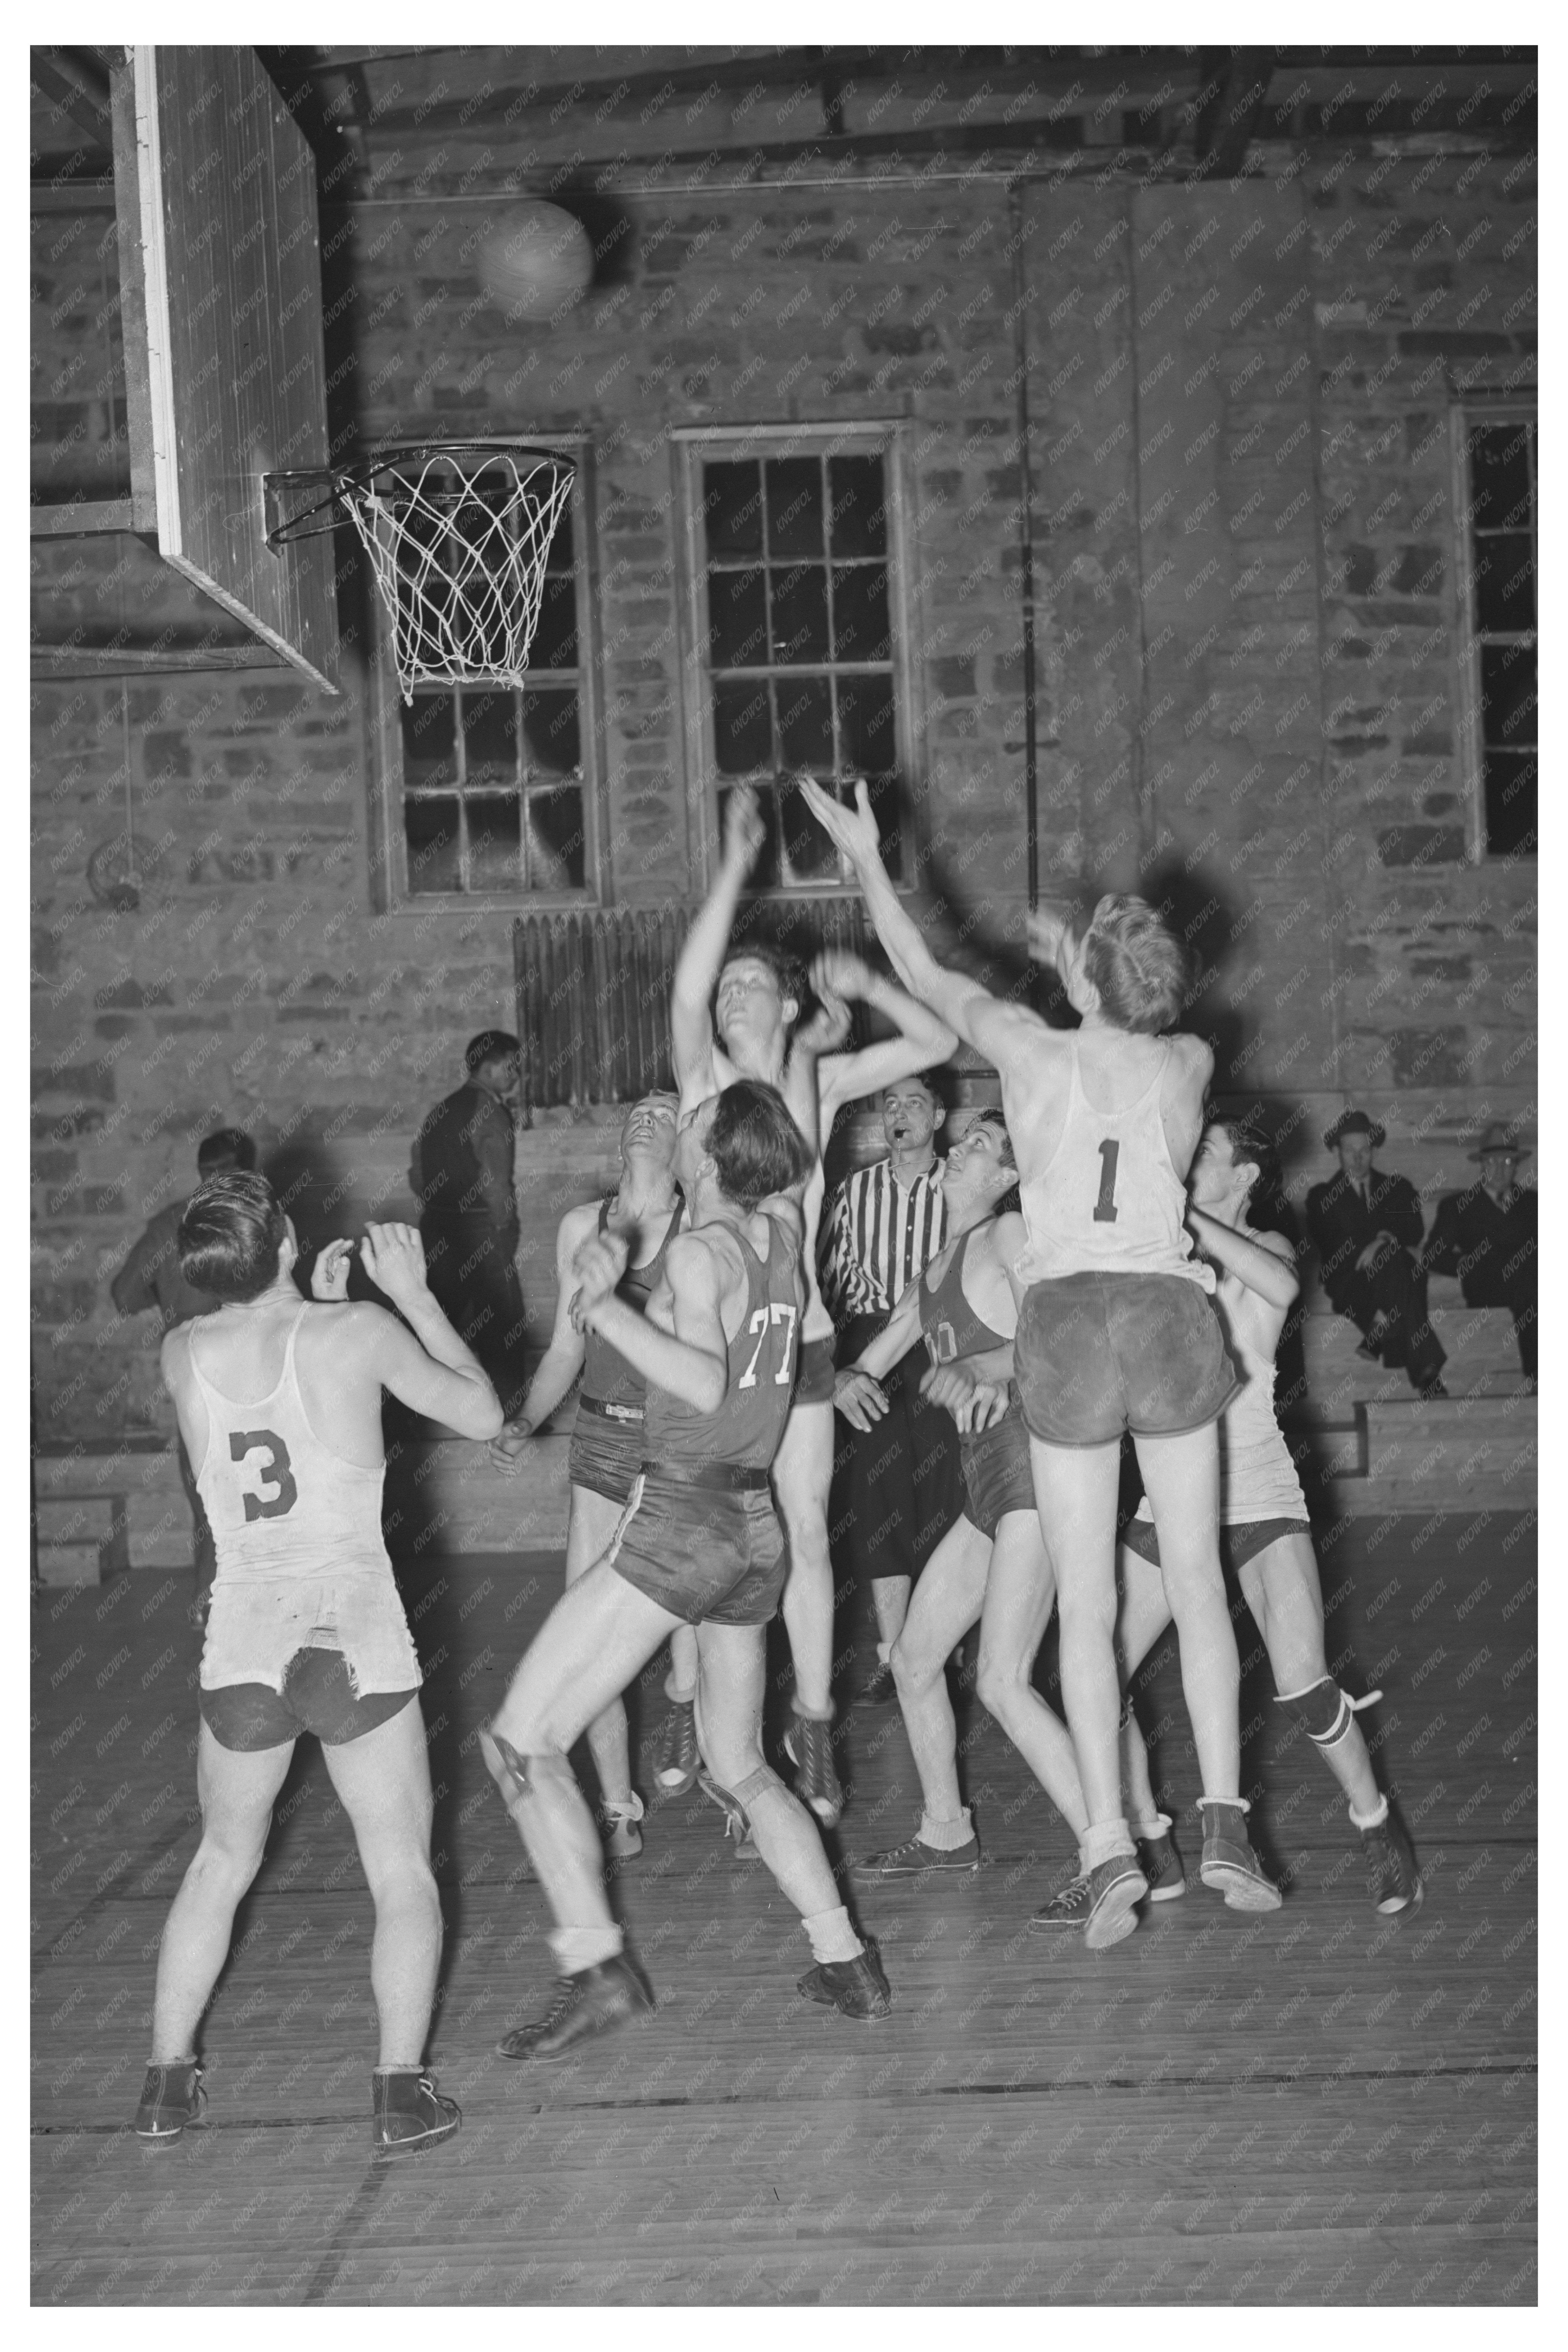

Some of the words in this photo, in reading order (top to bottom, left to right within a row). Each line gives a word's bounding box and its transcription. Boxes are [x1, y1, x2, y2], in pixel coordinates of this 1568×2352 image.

[1094, 1138, 1119, 1222] 1
[739, 1303, 796, 1389] 77
[229, 1429, 297, 1522] 3
